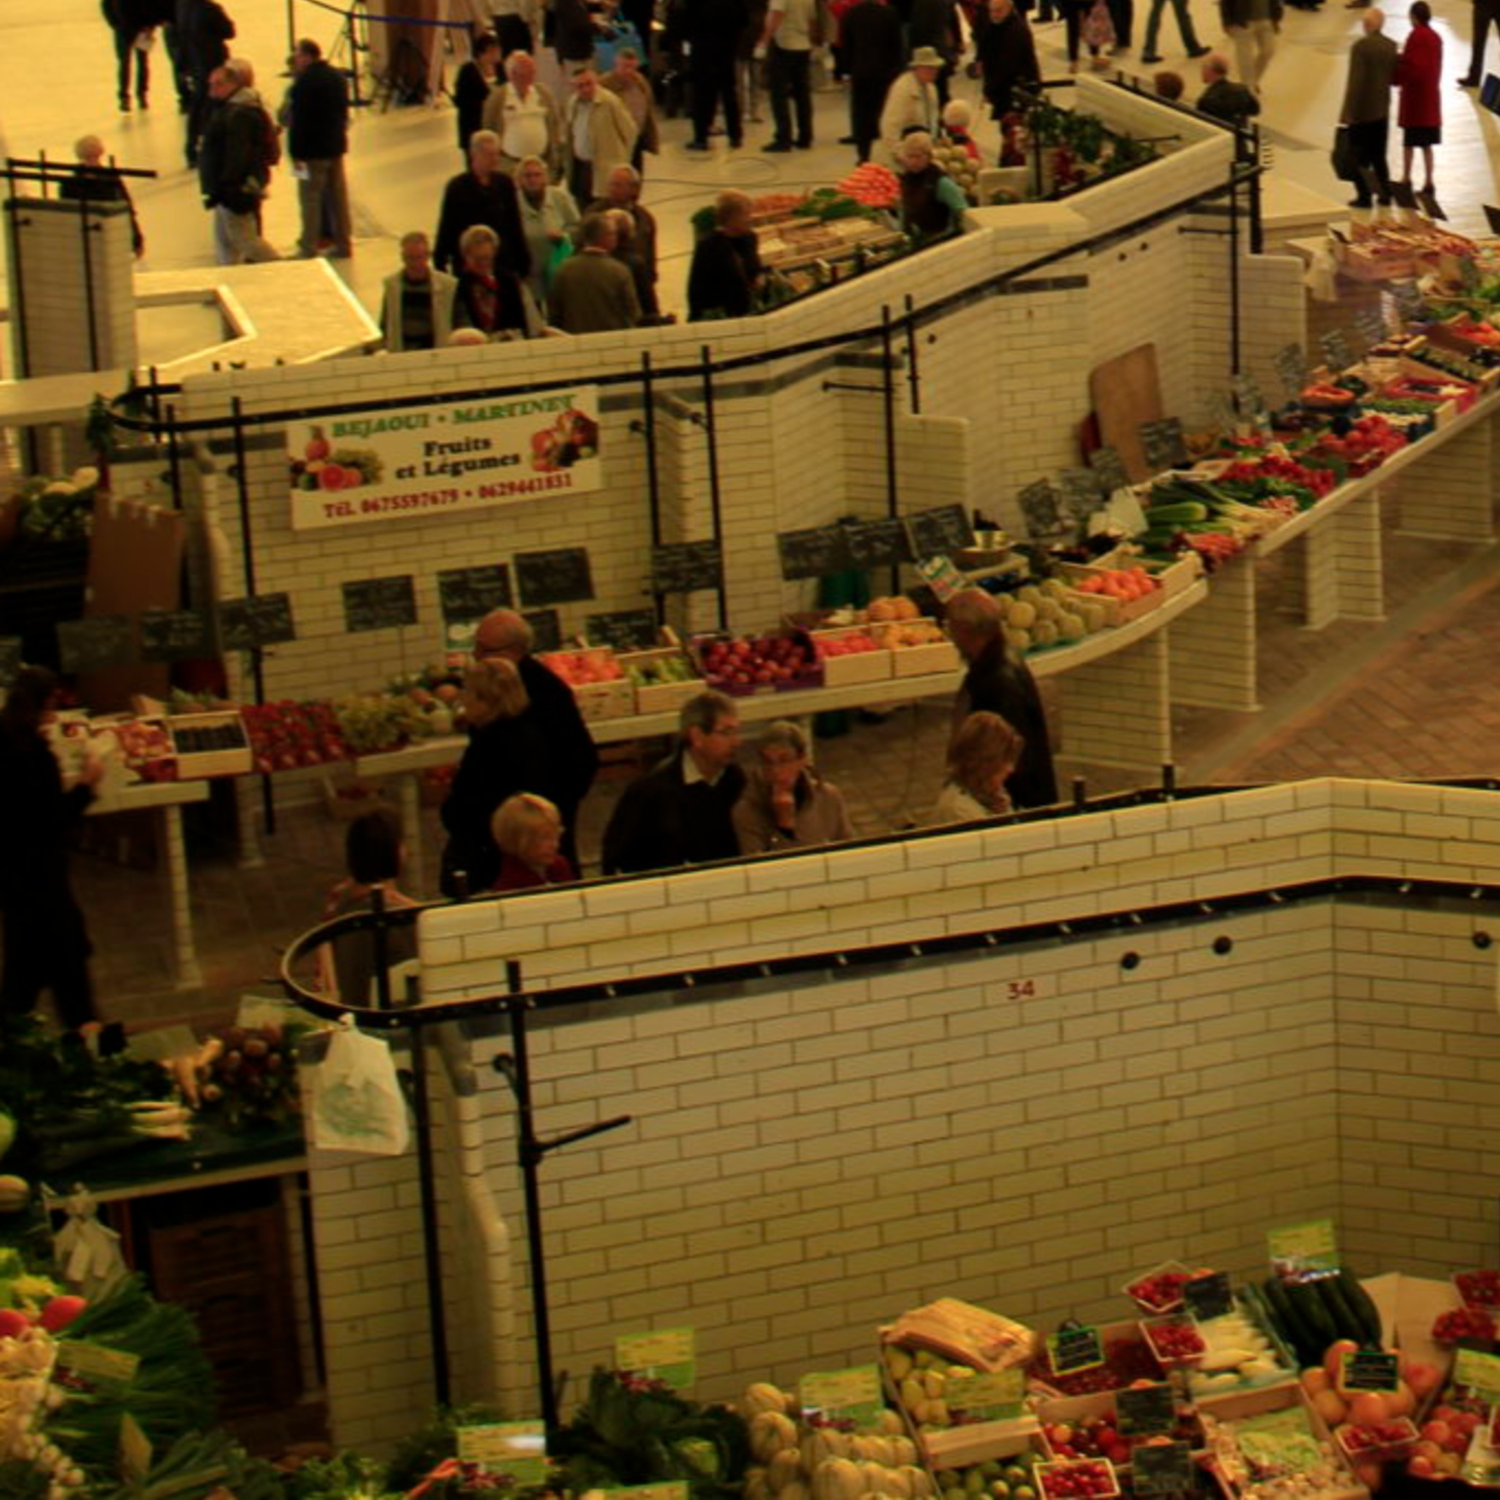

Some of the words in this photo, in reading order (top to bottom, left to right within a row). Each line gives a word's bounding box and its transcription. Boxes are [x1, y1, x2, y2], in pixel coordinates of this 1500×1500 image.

[332, 413, 429, 439] BEJAOUI
[422, 436, 492, 457] Fruits
[396, 465, 416, 479] et
[423, 452, 521, 478] Légumes
[1007, 980, 1034, 1000] 34
